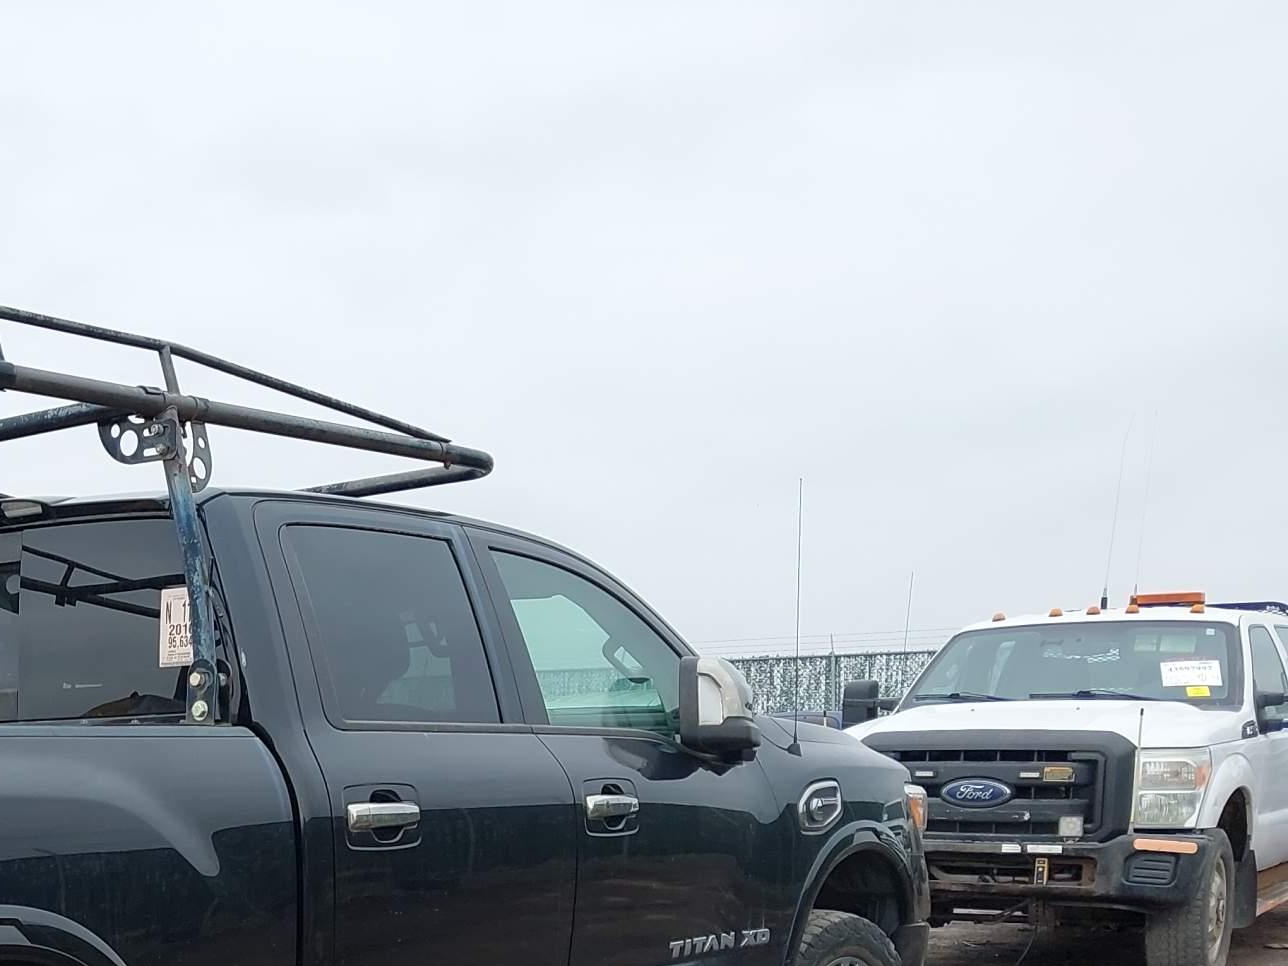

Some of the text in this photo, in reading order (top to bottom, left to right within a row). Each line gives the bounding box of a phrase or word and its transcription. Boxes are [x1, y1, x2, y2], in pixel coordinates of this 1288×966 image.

[165, 600, 172, 625] N
[955, 784, 994, 800] Ford
[668, 927, 771, 959] TITAN XD
